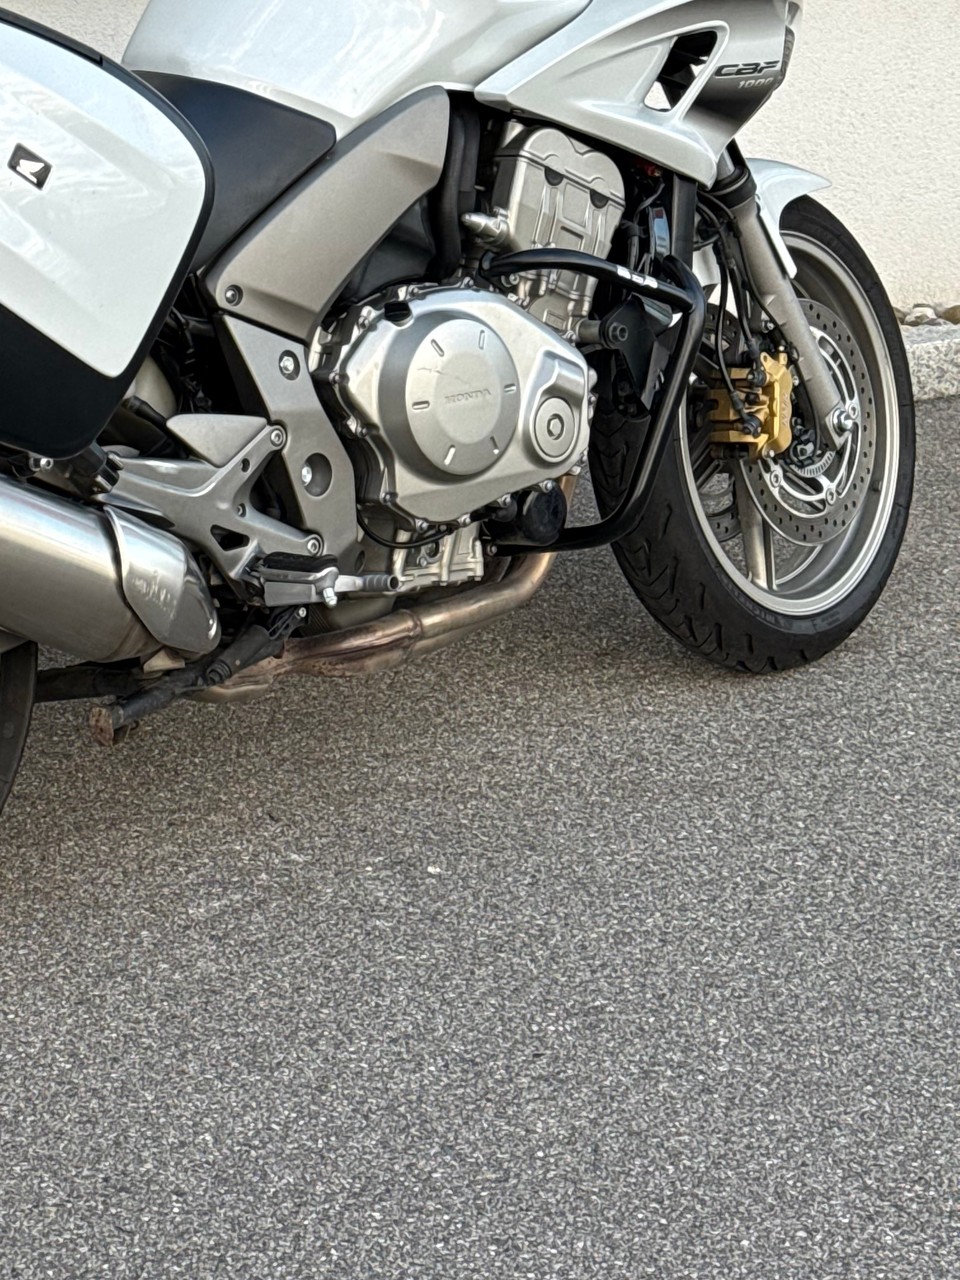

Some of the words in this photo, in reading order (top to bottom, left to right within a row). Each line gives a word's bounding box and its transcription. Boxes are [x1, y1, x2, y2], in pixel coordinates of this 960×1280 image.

[714, 60, 780, 77] CBF
[738, 77, 774, 88] 1000
[444, 388, 492, 404] HONDA
